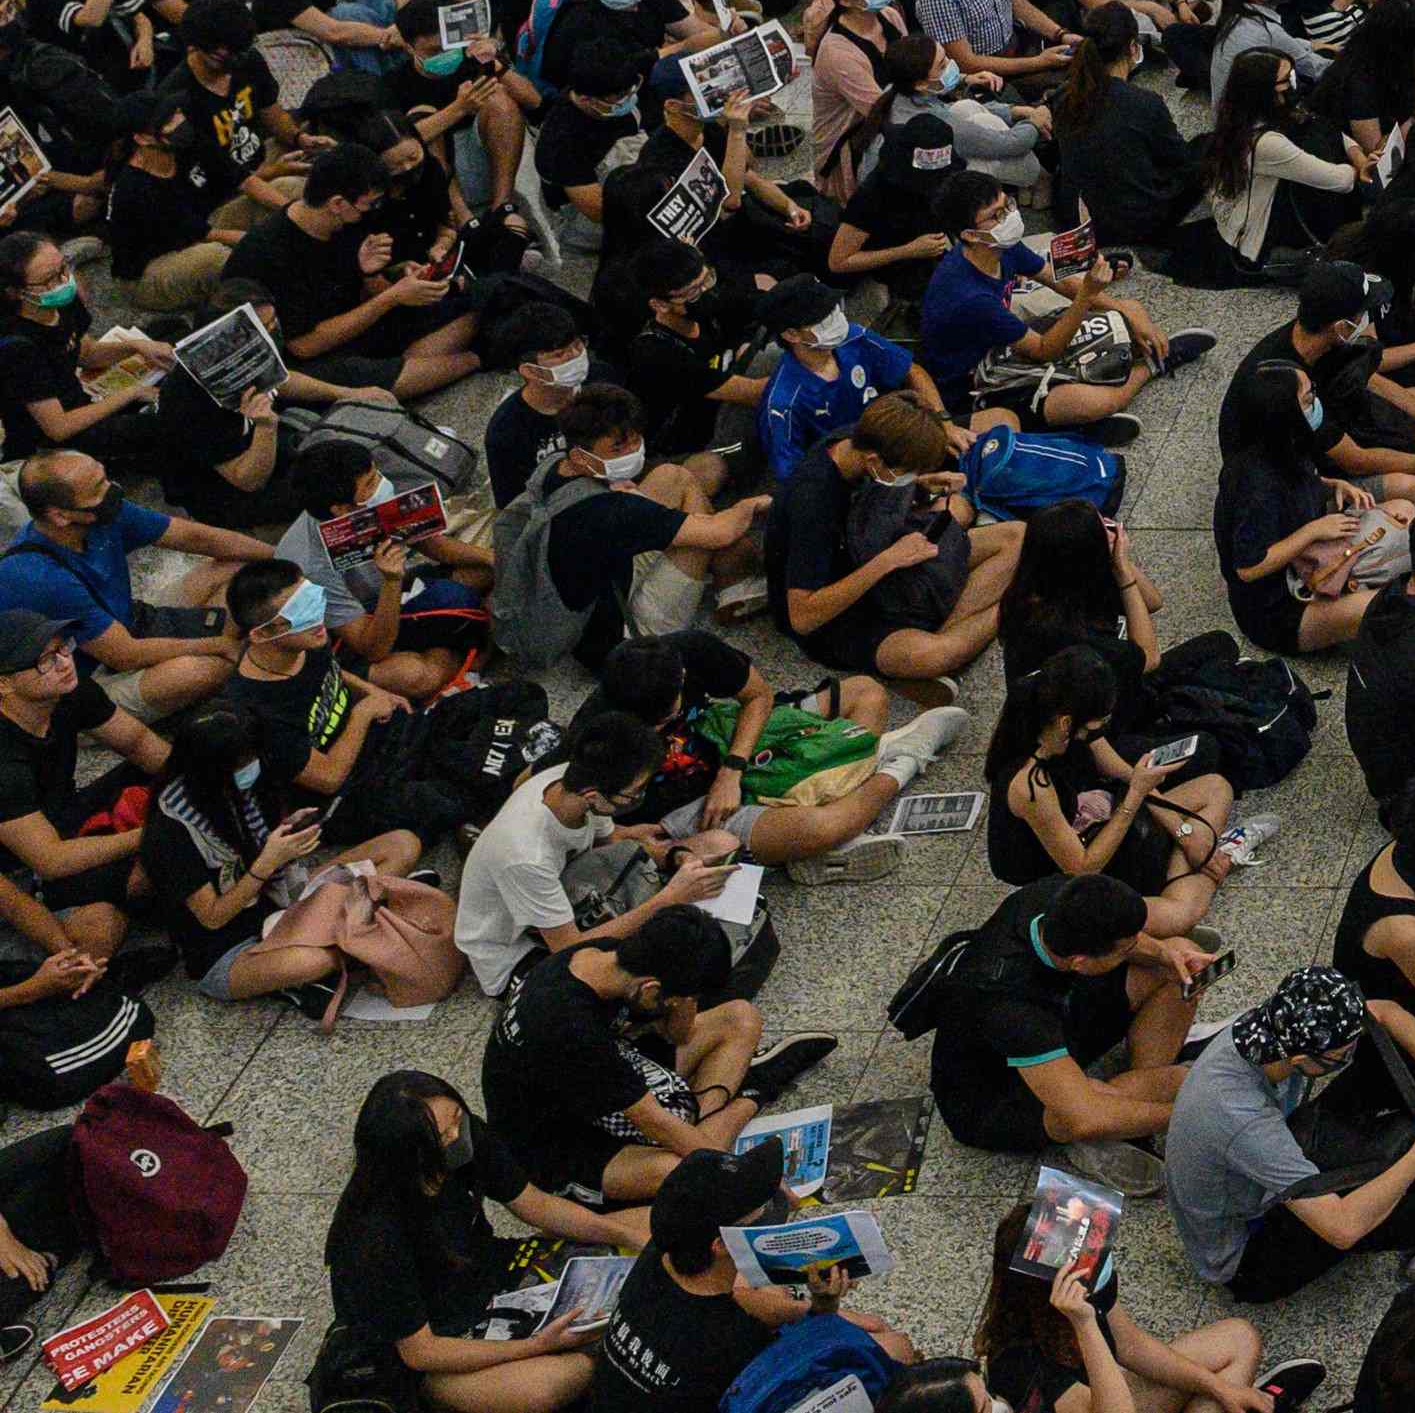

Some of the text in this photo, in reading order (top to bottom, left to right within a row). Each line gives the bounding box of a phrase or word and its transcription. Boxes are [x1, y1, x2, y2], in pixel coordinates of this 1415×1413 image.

[657, 194, 686, 226] THEY
[50, 1304, 142, 1357] PROTESTERS
[64, 1309, 148, 1361] GANGSTERS
[93, 1320, 158, 1370] MAKE
[121, 1300, 198, 1395] HUMANITARIAN
